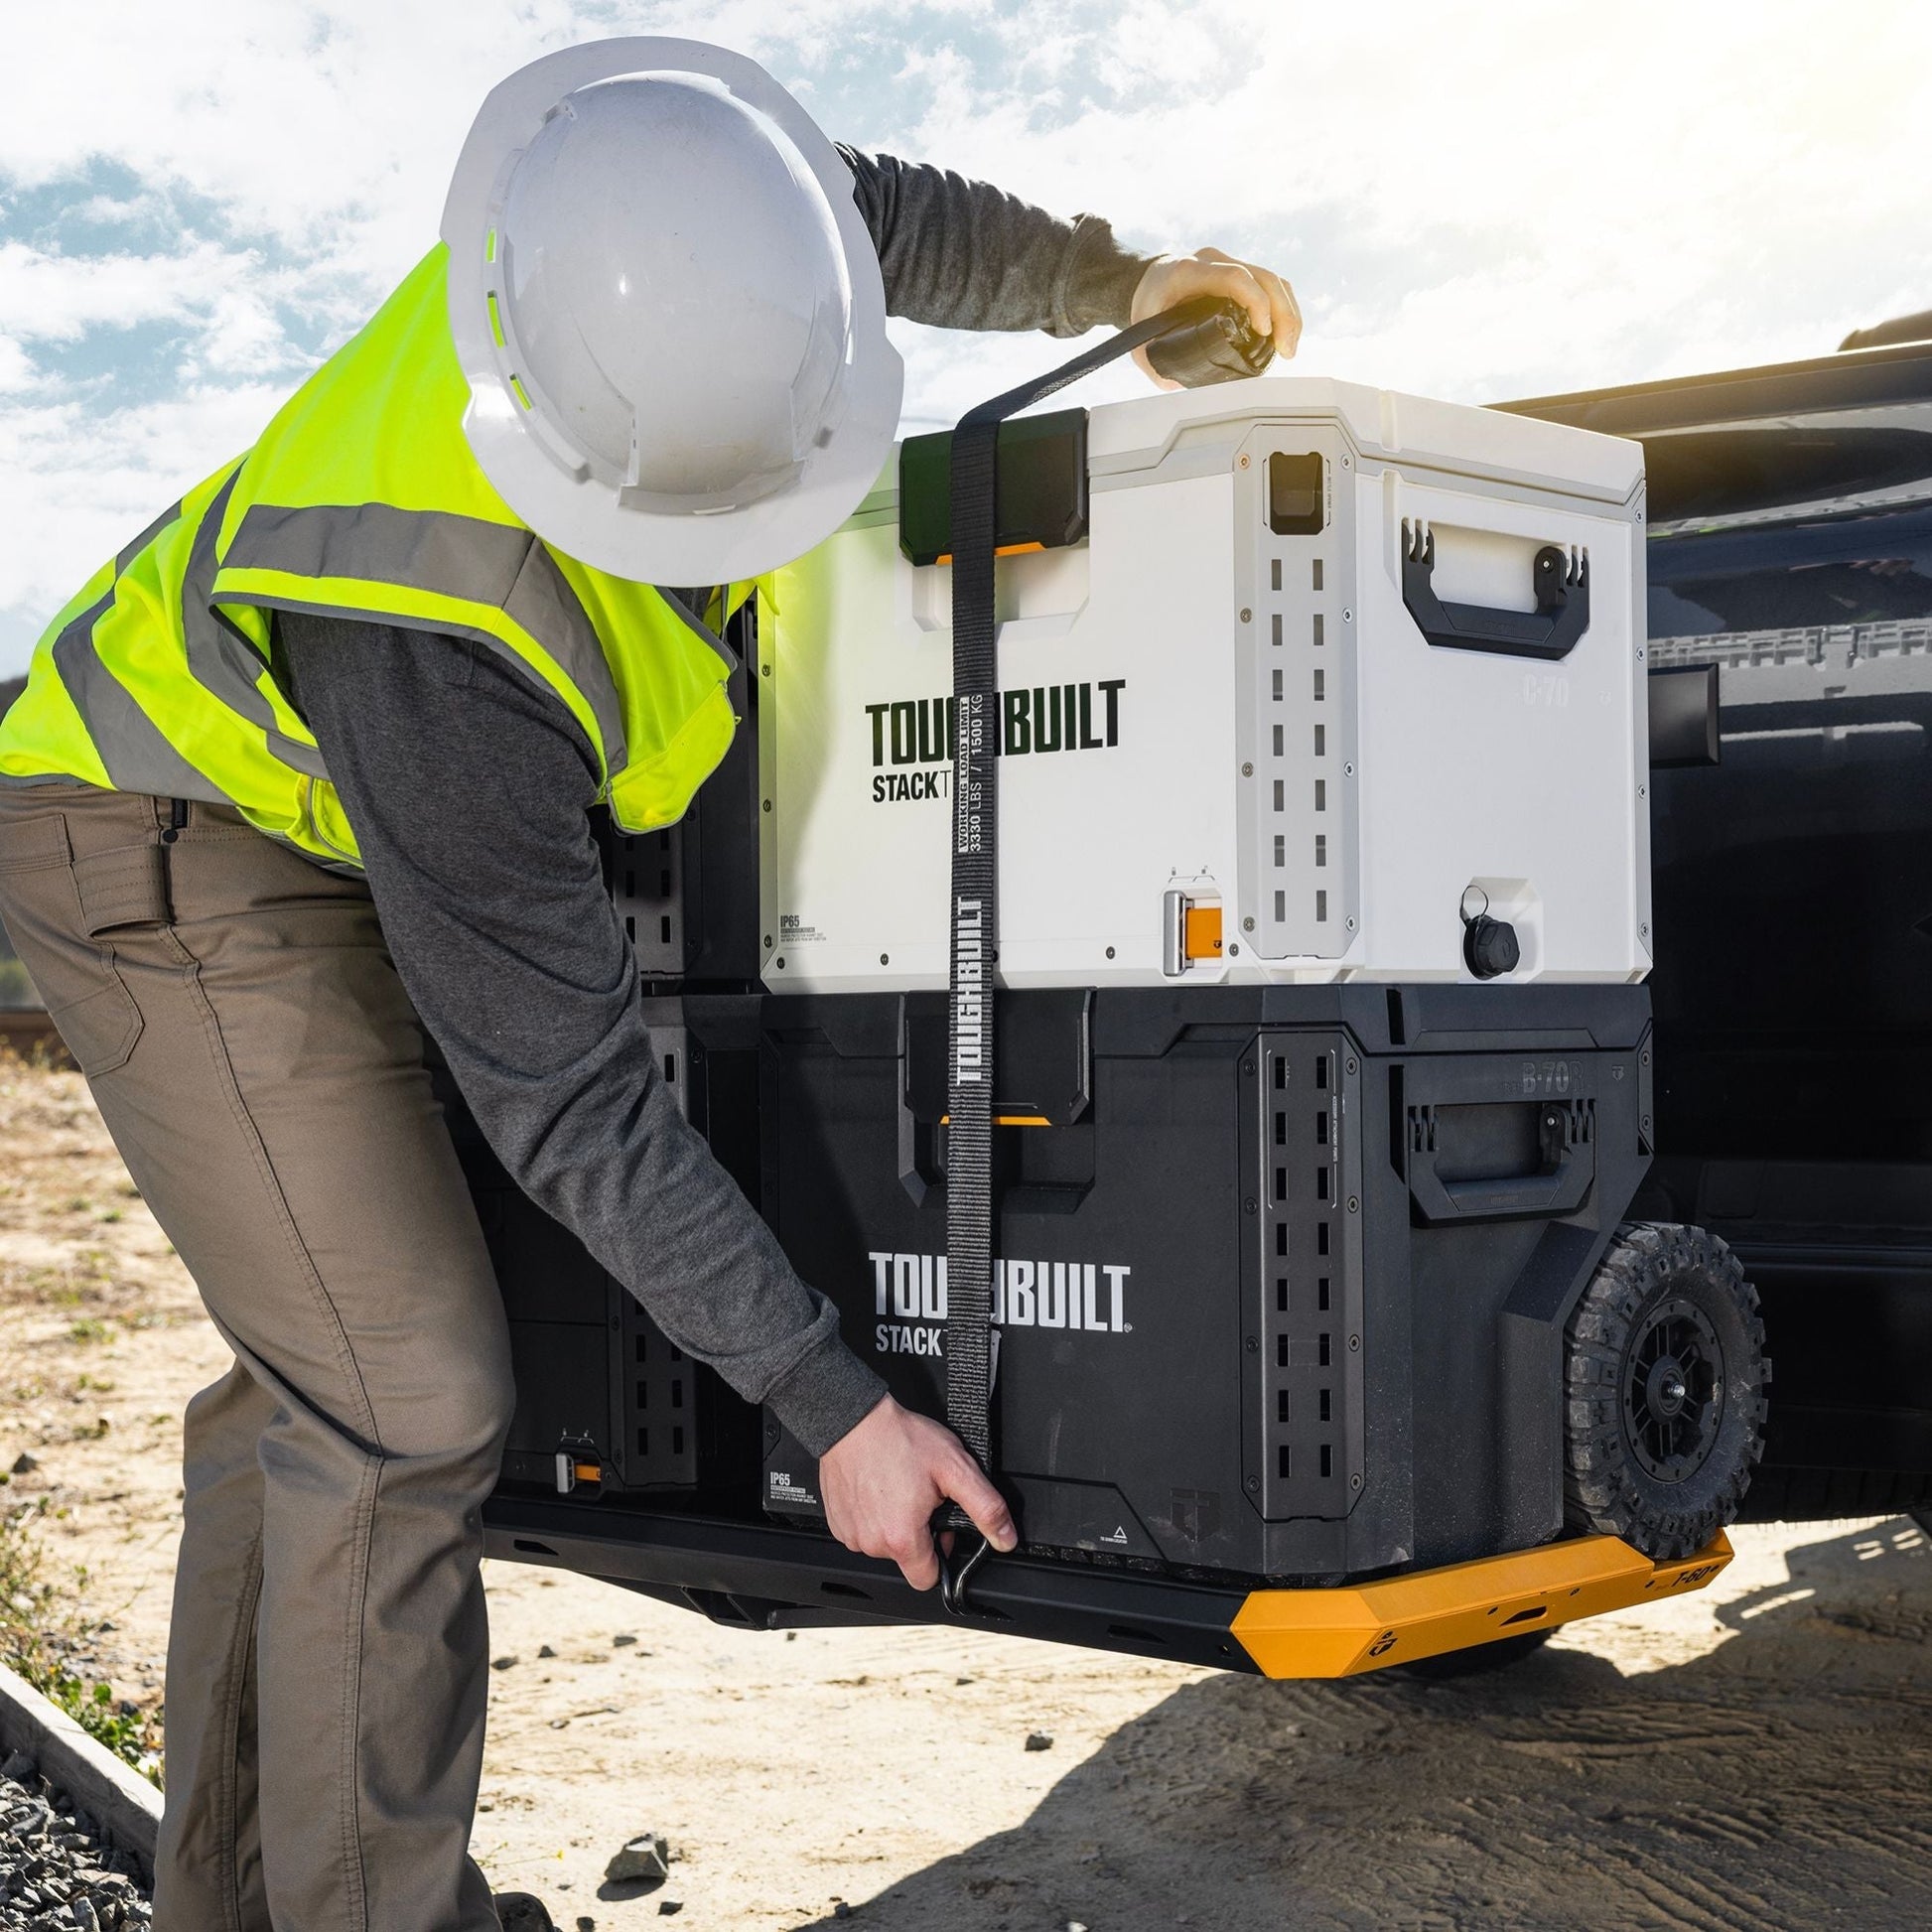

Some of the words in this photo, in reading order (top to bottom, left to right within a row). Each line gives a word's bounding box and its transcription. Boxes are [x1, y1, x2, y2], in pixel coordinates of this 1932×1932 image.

[971, 694, 983, 714] KG
[866, 679, 1126, 766] TOUBUILT
[971, 718, 983, 756] 1500
[960, 743, 969, 779] LOAD
[873, 769, 952, 803] STACKT
[971, 781, 982, 810] LBS
[959, 782, 969, 849] WORKING
[970, 815, 981, 852] 3330
[779, 914, 800, 928] IP65
[956, 896, 982, 1086] TOUGHBUILT
[868, 1251, 1131, 1333] TOUBUILT
[876, 1323, 948, 1357] STACK
[769, 1471, 791, 1486] IP65
